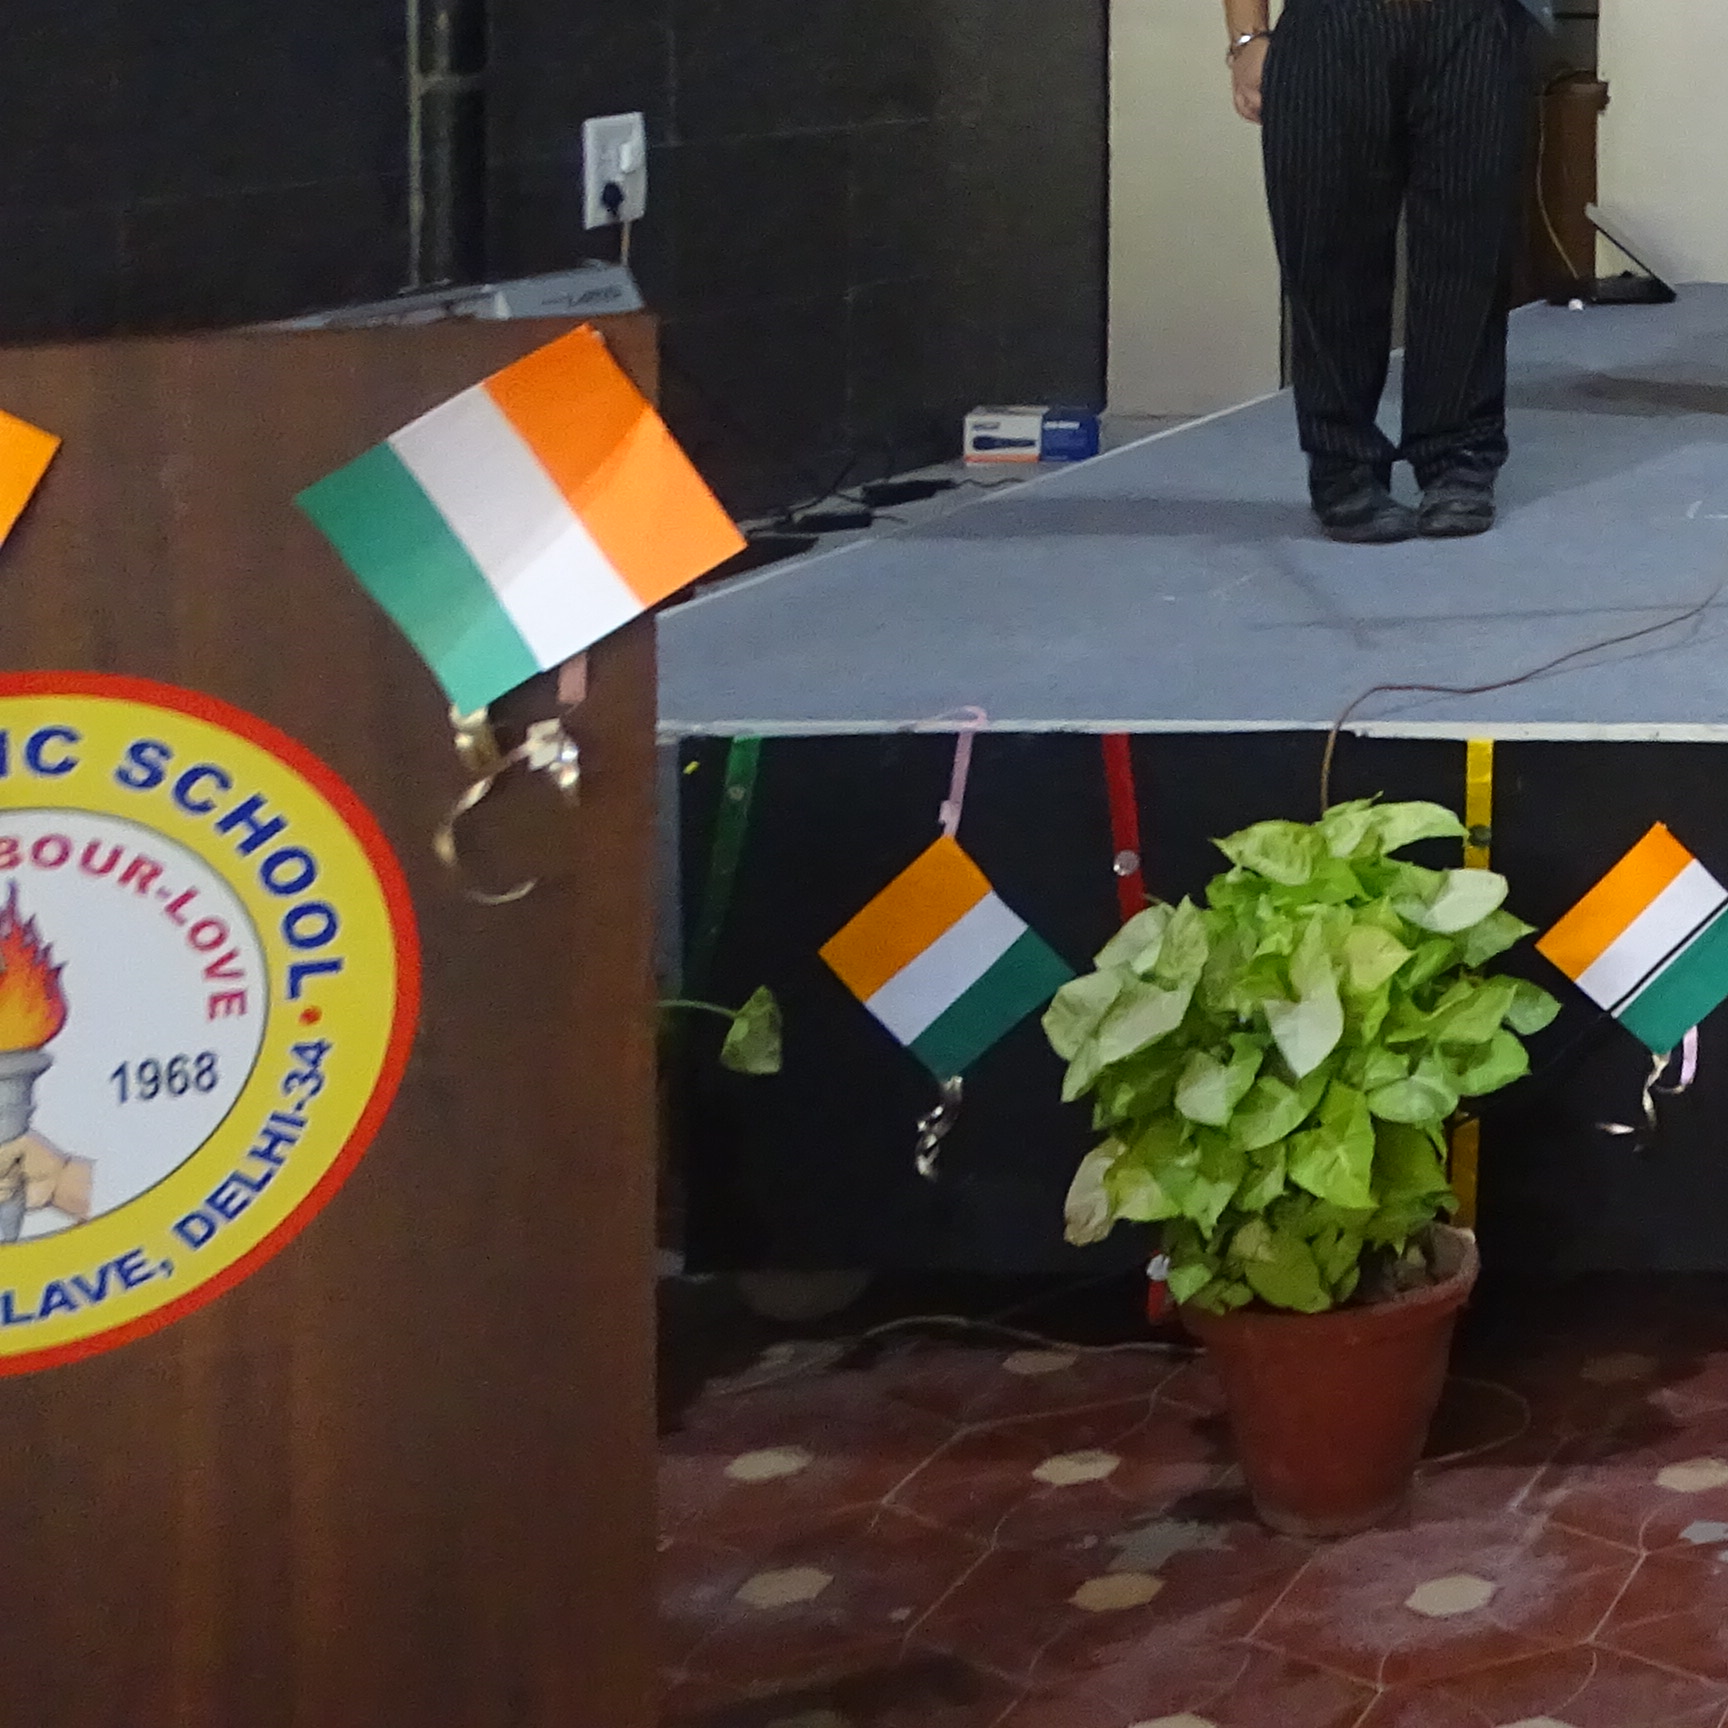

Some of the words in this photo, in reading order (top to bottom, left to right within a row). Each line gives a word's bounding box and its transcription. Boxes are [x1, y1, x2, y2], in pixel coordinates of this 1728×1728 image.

[113, 738, 342, 1002] SCHOOL
[109, 1050, 220, 1104] 1968
[171, 1039, 334, 1250] DELHI-34
